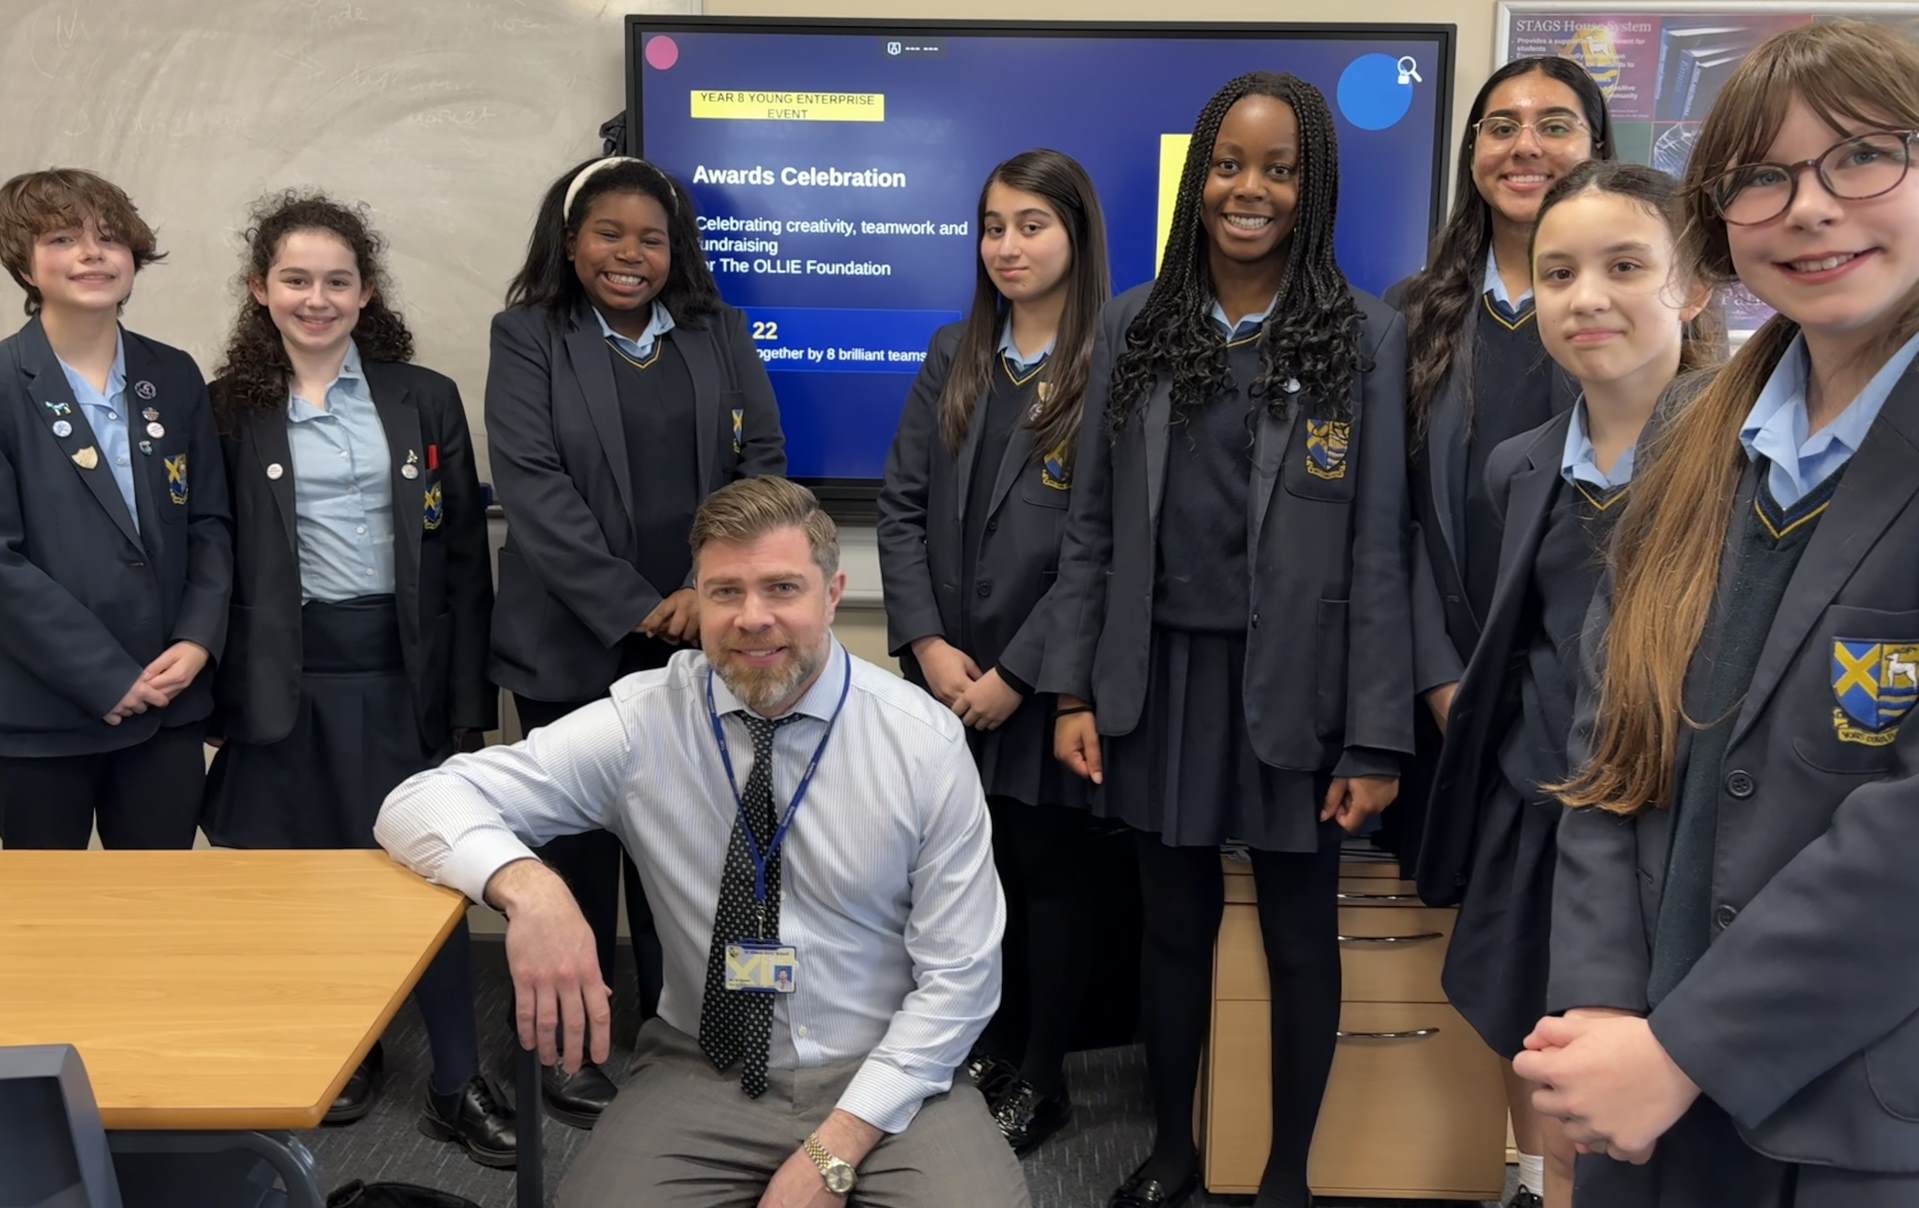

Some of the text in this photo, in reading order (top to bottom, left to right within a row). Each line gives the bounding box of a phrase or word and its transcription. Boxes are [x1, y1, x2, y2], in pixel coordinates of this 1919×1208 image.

[1516, 20, 1652, 33] STAGS House System
[700, 92, 875, 105] YEAR 8 YOUNG ENTERPRISE
[767, 108, 808, 119] EVENT
[693, 165, 906, 187] Awards Celebration
[696, 216, 968, 236] Celebrating creativity, teamwork and
[698, 236, 779, 256] undraising
[719, 258, 750, 273] The
[753, 259, 802, 274] OLLIE
[806, 260, 891, 276] Foundation
[752, 321, 778, 340] 22
[807, 347, 824, 363] by
[826, 347, 836, 361] 8
[838, 347, 885, 361] brilliant
[887, 349, 928, 362] teams
